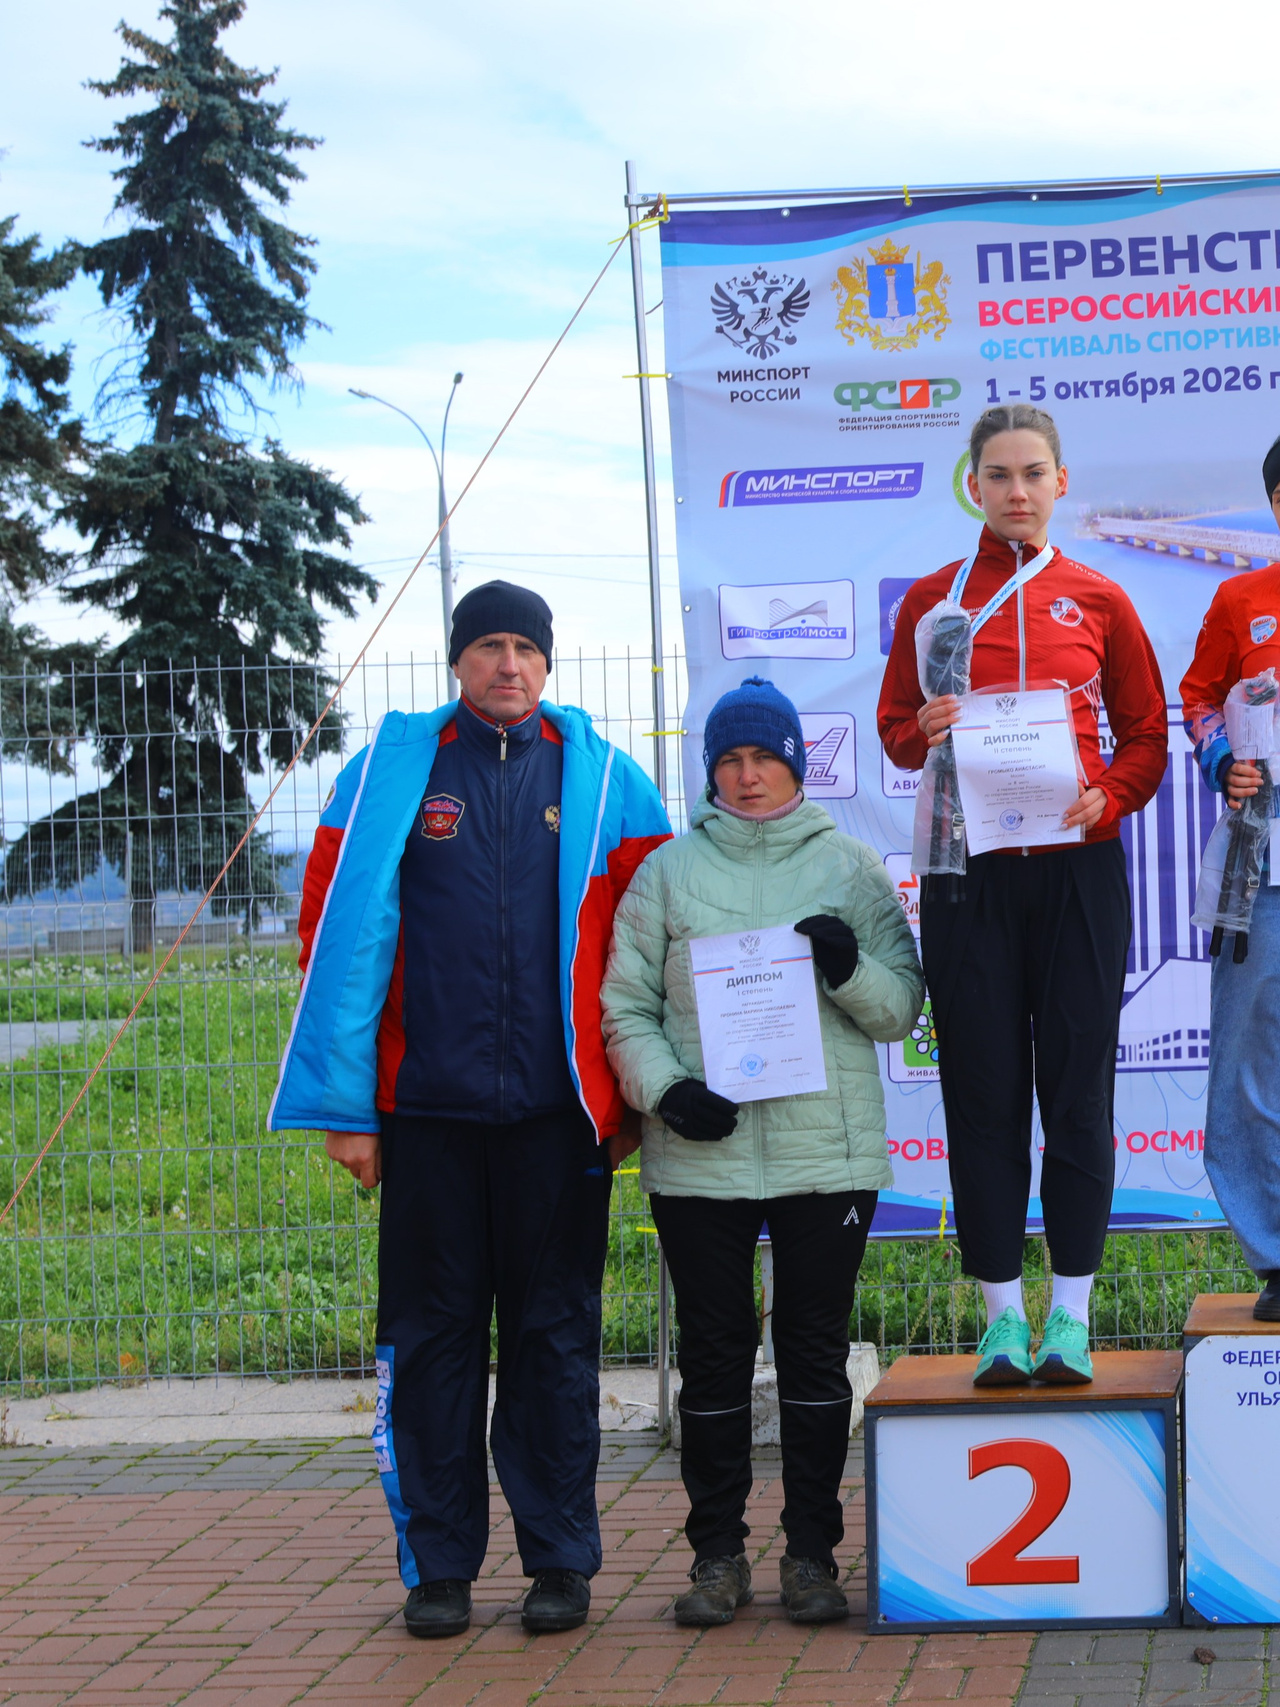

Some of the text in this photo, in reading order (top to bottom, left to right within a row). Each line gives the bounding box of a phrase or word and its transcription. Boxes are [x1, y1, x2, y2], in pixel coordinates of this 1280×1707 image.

[979, 332, 1141, 362] ФЕСТИВАЛЬ
[717, 366, 811, 383] МИНСПОРТ
[986, 378, 1000, 403] 1
[1029, 376, 1046, 402] 5
[1054, 371, 1175, 404] октября
[1183, 365, 1262, 394] 2026
[730, 387, 801, 403] РОССИИ
[838, 412, 961, 424] ФЕДЕРАЦИЯ СПОРТИВНОГО
[838, 420, 961, 432] ОРИЕНТИРОВАНИЯ РОССИИ
[746, 468, 915, 493] МИНСПОРТ
[983, 732, 1041, 746] ДИПЛОМ
[1000, 746, 1032, 754] степень
[892, 780, 921, 791] АВИ
[726, 970, 783, 989] ДИПЛОМ
[741, 987, 774, 996] степень
[907, 1069, 941, 1077] ЖИВАЯ
[1126, 1129, 1205, 1154] ОСМ
[966, 1437, 1080, 1587] 2
